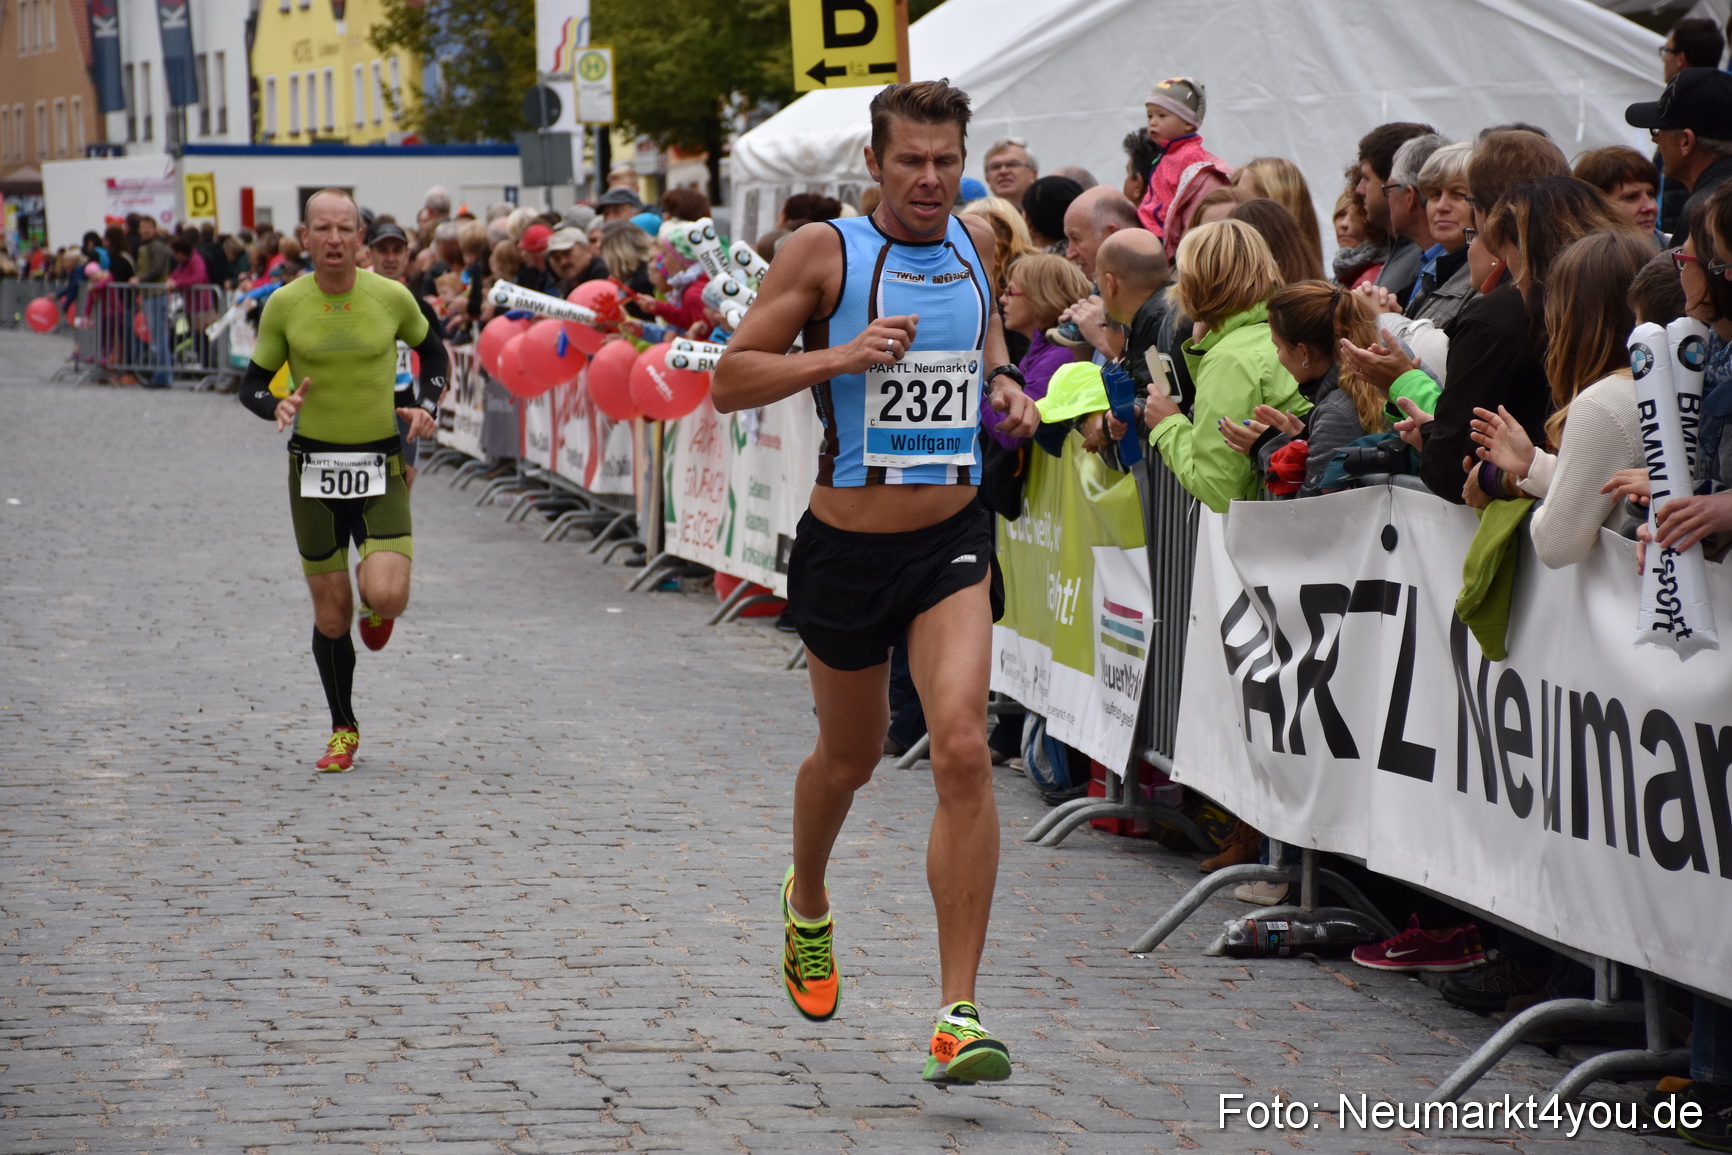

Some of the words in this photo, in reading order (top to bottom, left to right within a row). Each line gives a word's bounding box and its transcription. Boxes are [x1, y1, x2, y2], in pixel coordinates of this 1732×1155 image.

[192, 185, 209, 209] D
[514, 297, 545, 312] BMW
[914, 363, 967, 373] Neumarkt
[879, 379, 969, 423] 2321
[891, 434, 961, 454] Wolfgang
[1637, 399, 1669, 481] BMW
[320, 469, 370, 496] 500
